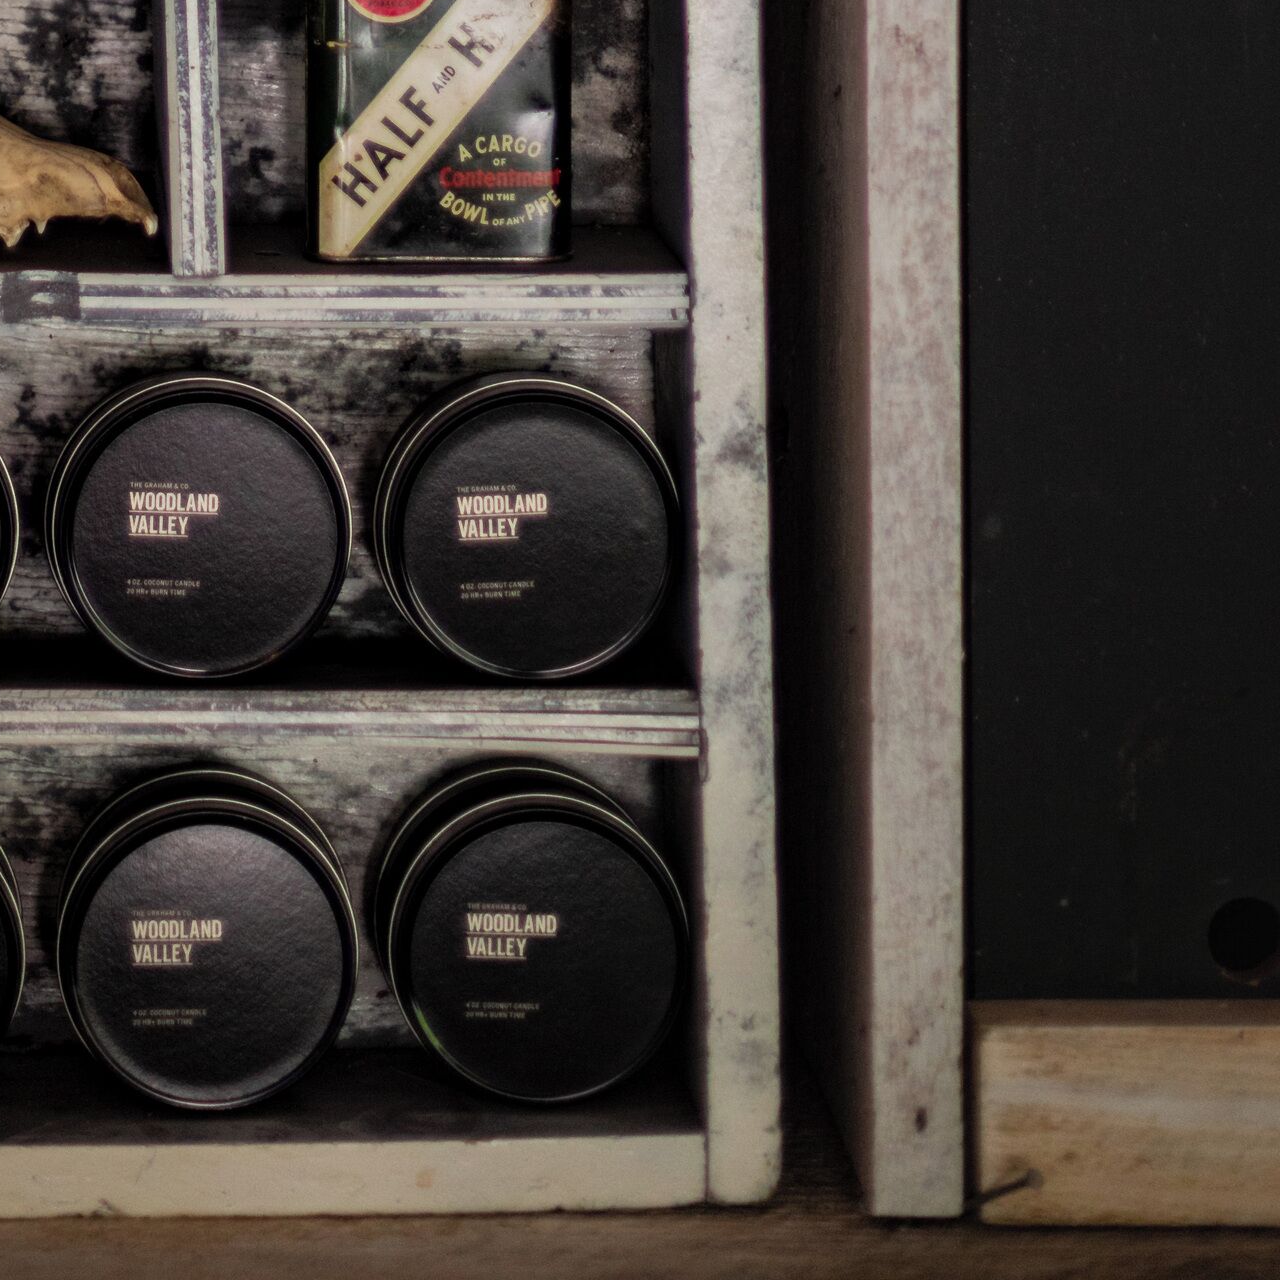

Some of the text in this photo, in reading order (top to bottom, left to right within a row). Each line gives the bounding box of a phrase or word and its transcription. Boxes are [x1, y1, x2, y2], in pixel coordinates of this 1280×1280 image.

[331, 65, 456, 208] HALF AND
[459, 134, 542, 162] A CARGO
[493, 158, 506, 166] OF
[439, 166, 560, 189] Contentment
[439, 190, 488, 225] BOWL
[506, 216, 525, 225] ANY
[524, 189, 561, 221] PIPE
[483, 193, 516, 201] IN THE
[130, 492, 219, 512] WOODLAND
[457, 493, 547, 515] WOODLAND
[129, 515, 188, 535] VALLEY
[458, 518, 517, 538] VALLEY
[133, 919, 222, 939] WOODLAND
[467, 913, 557, 933] WOODLAND
[133, 944, 192, 963] VALLEY
[467, 937, 526, 956] VALLEY
